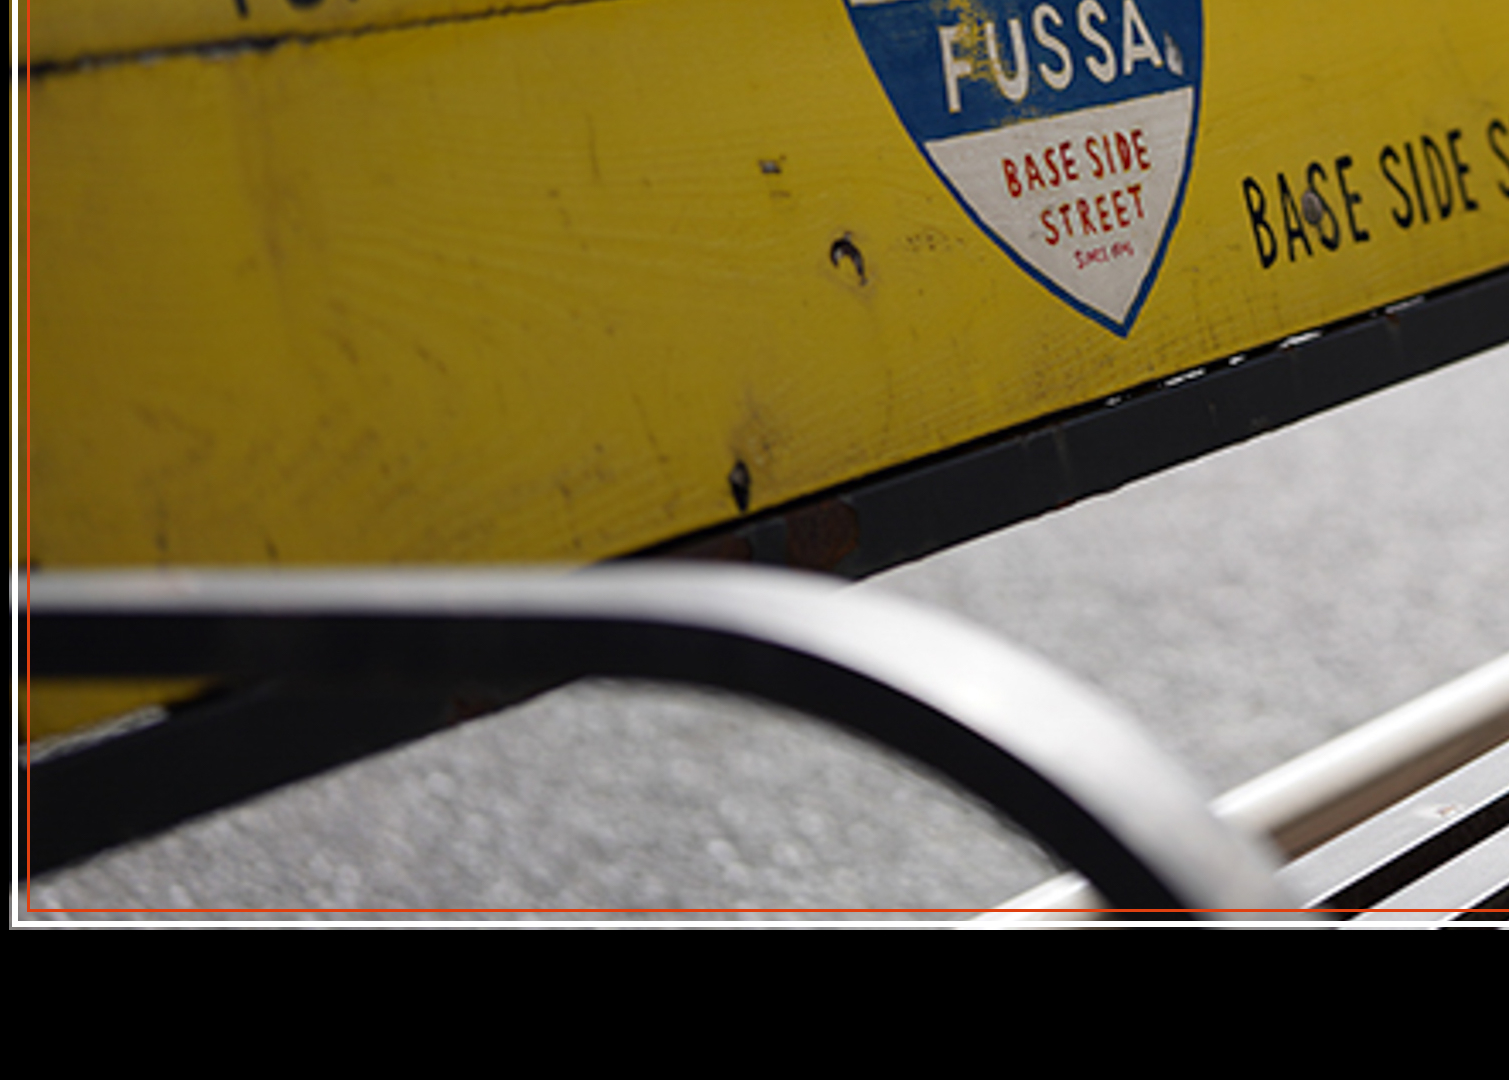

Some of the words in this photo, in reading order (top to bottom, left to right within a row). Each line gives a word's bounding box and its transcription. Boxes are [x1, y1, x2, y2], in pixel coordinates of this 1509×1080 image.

[1002, 140, 1080, 199] BASE
[1085, 128, 1151, 180] SIDE
[1243, 155, 1370, 269] BASE
[1379, 129, 1479, 229] SIDE
[1040, 182, 1145, 247] STREET
